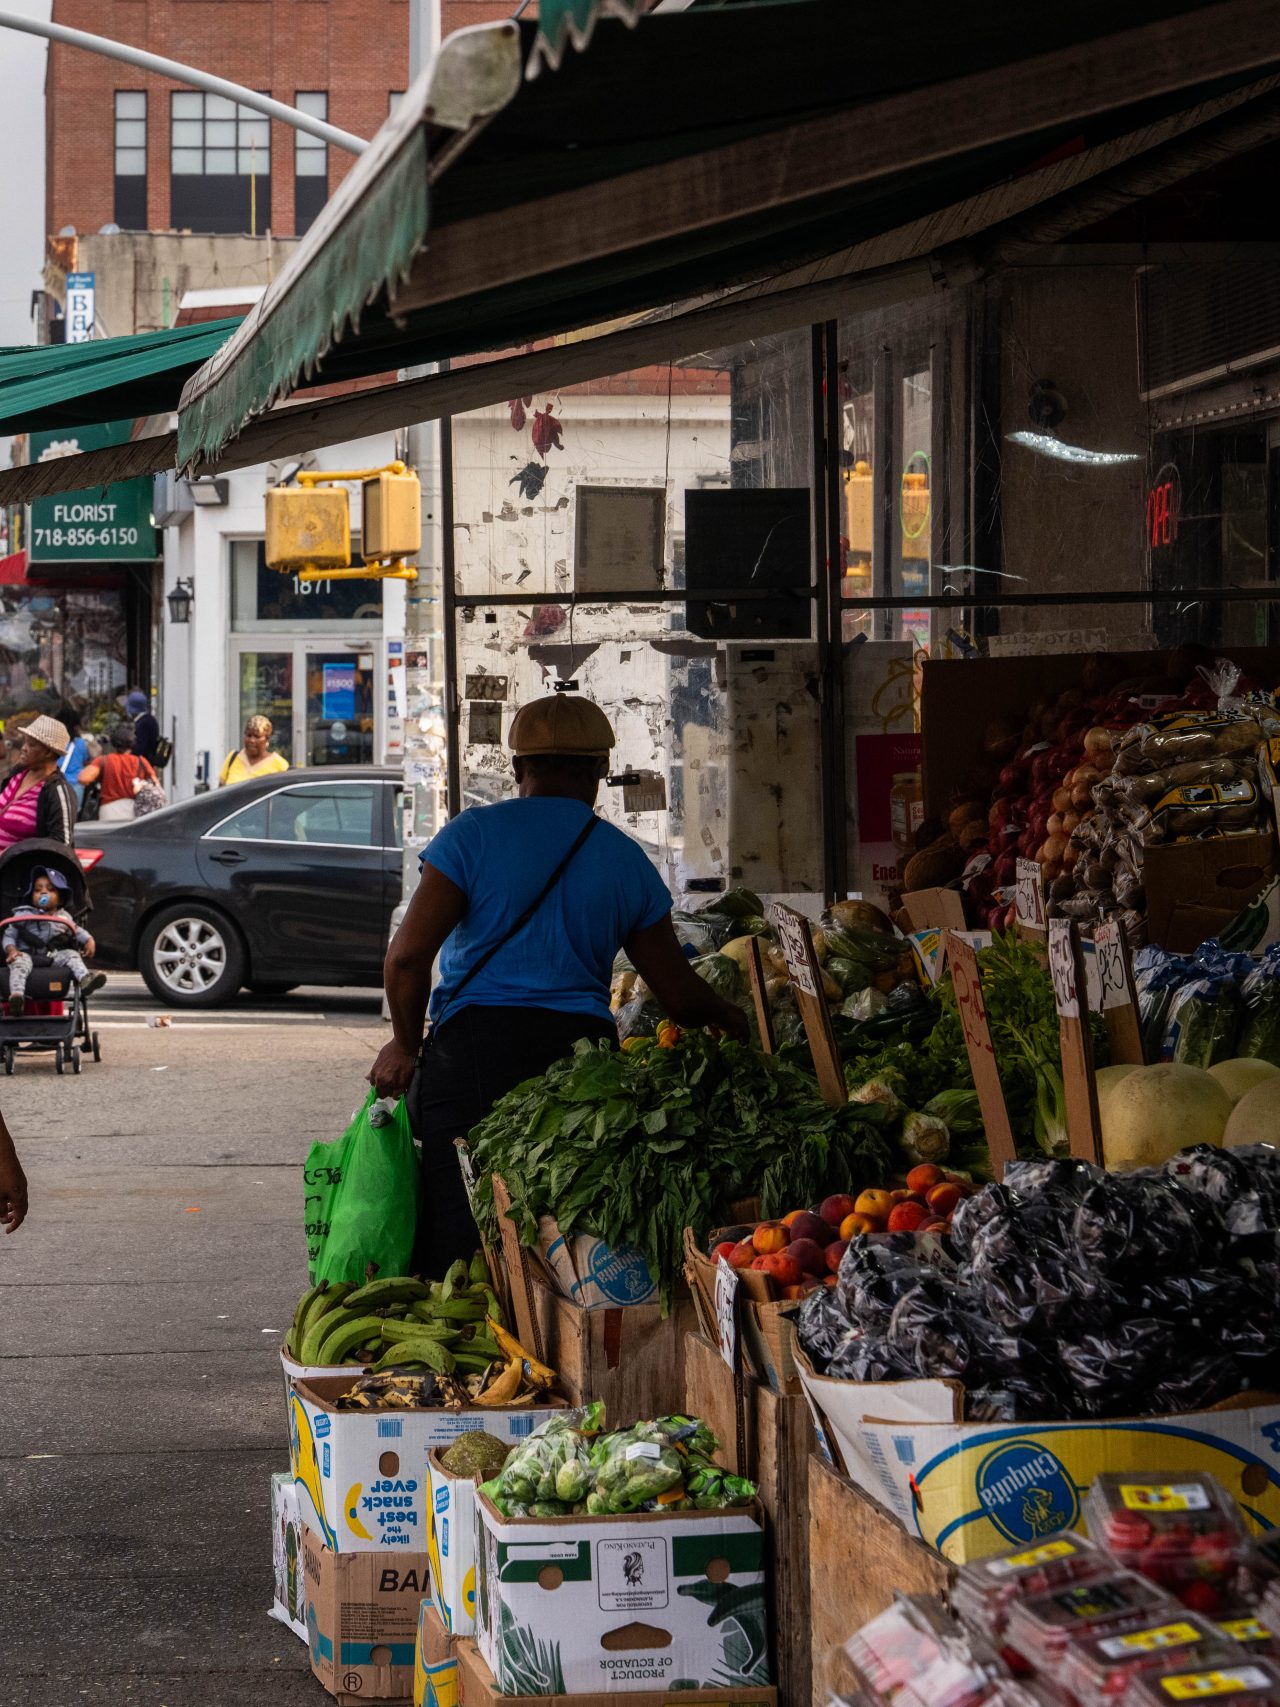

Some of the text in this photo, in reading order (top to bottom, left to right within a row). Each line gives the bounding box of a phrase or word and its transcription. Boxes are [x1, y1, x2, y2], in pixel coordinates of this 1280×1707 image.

[54, 504, 117, 522] FLORIST
[34, 528, 138, 546] 718-856-6150
[292, 575, 331, 595] 1871
[370, 1480, 417, 1494] ever
[979, 1451, 1060, 1510] Chiquita
[362, 1496, 413, 1511] snack
[377, 1511, 417, 1526] best
[387, 1526, 402, 1535] the
[380, 1533, 410, 1545] likely
[599, 1657, 672, 1670] OF ECUADOR
[611, 1668, 665, 1680] PRODUCT
